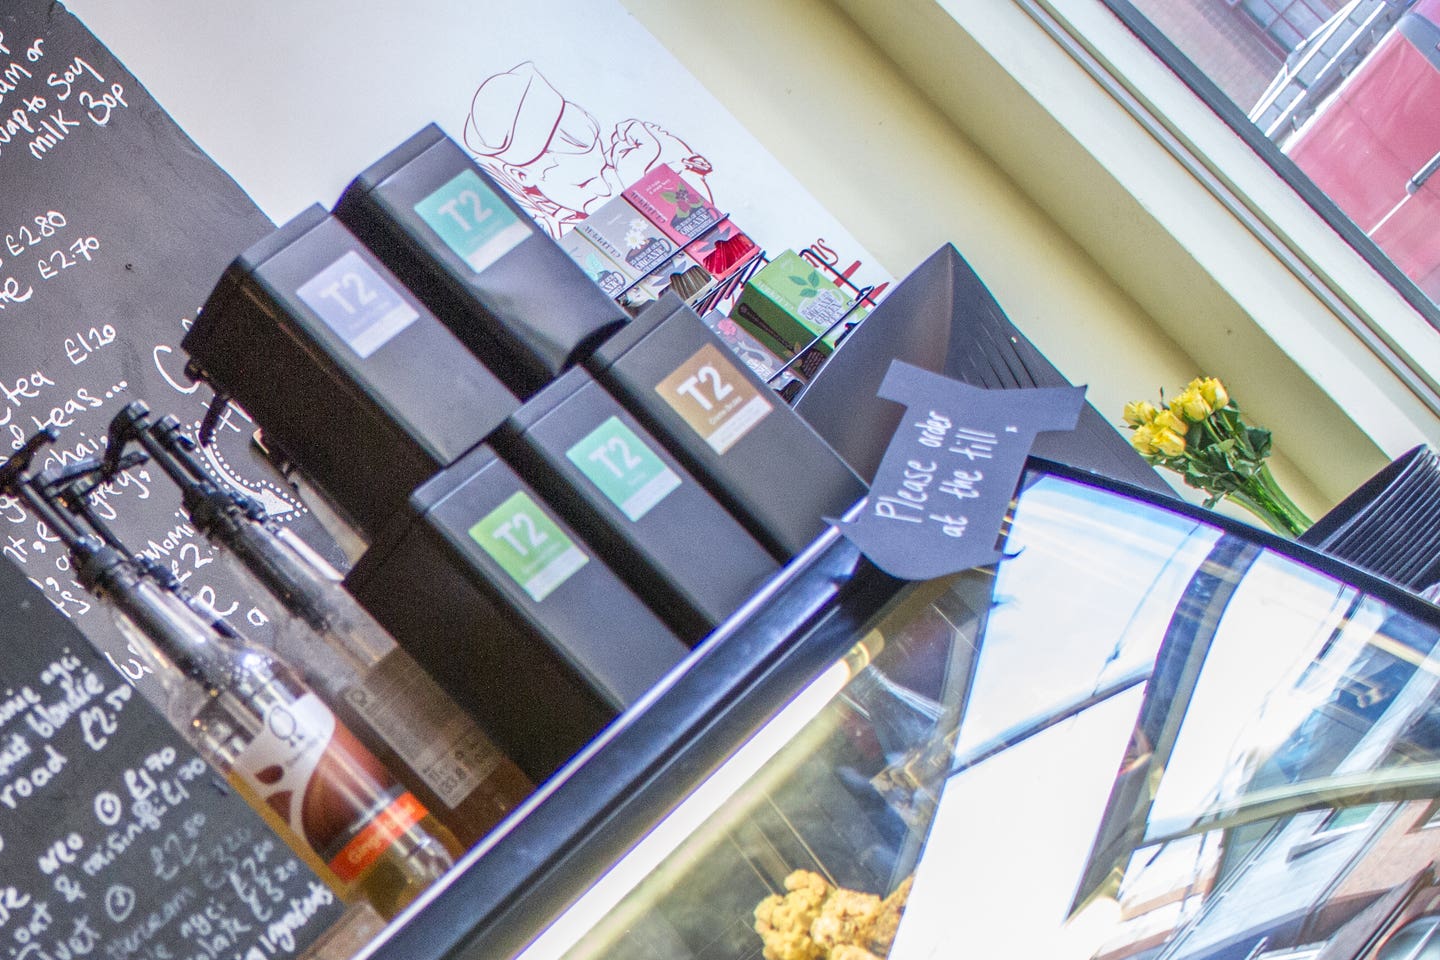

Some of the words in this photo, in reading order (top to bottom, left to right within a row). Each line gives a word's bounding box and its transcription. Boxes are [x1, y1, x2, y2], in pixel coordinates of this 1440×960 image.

[25, 39, 46, 65] or
[4, 209, 66, 257] £2.80
[438, 184, 498, 235] T2
[37, 236, 100, 280] £2.70
[319, 264, 380, 316] T2
[65, 324, 116, 365] £1.20
[675, 361, 734, 411] T2
[587, 435, 644, 483] T2
[874, 460, 937, 523] Please
[939, 470, 983, 500] the
[492, 512, 549, 560] T2
[929, 514, 968, 538] at
[0, 746, 67, 809] road
